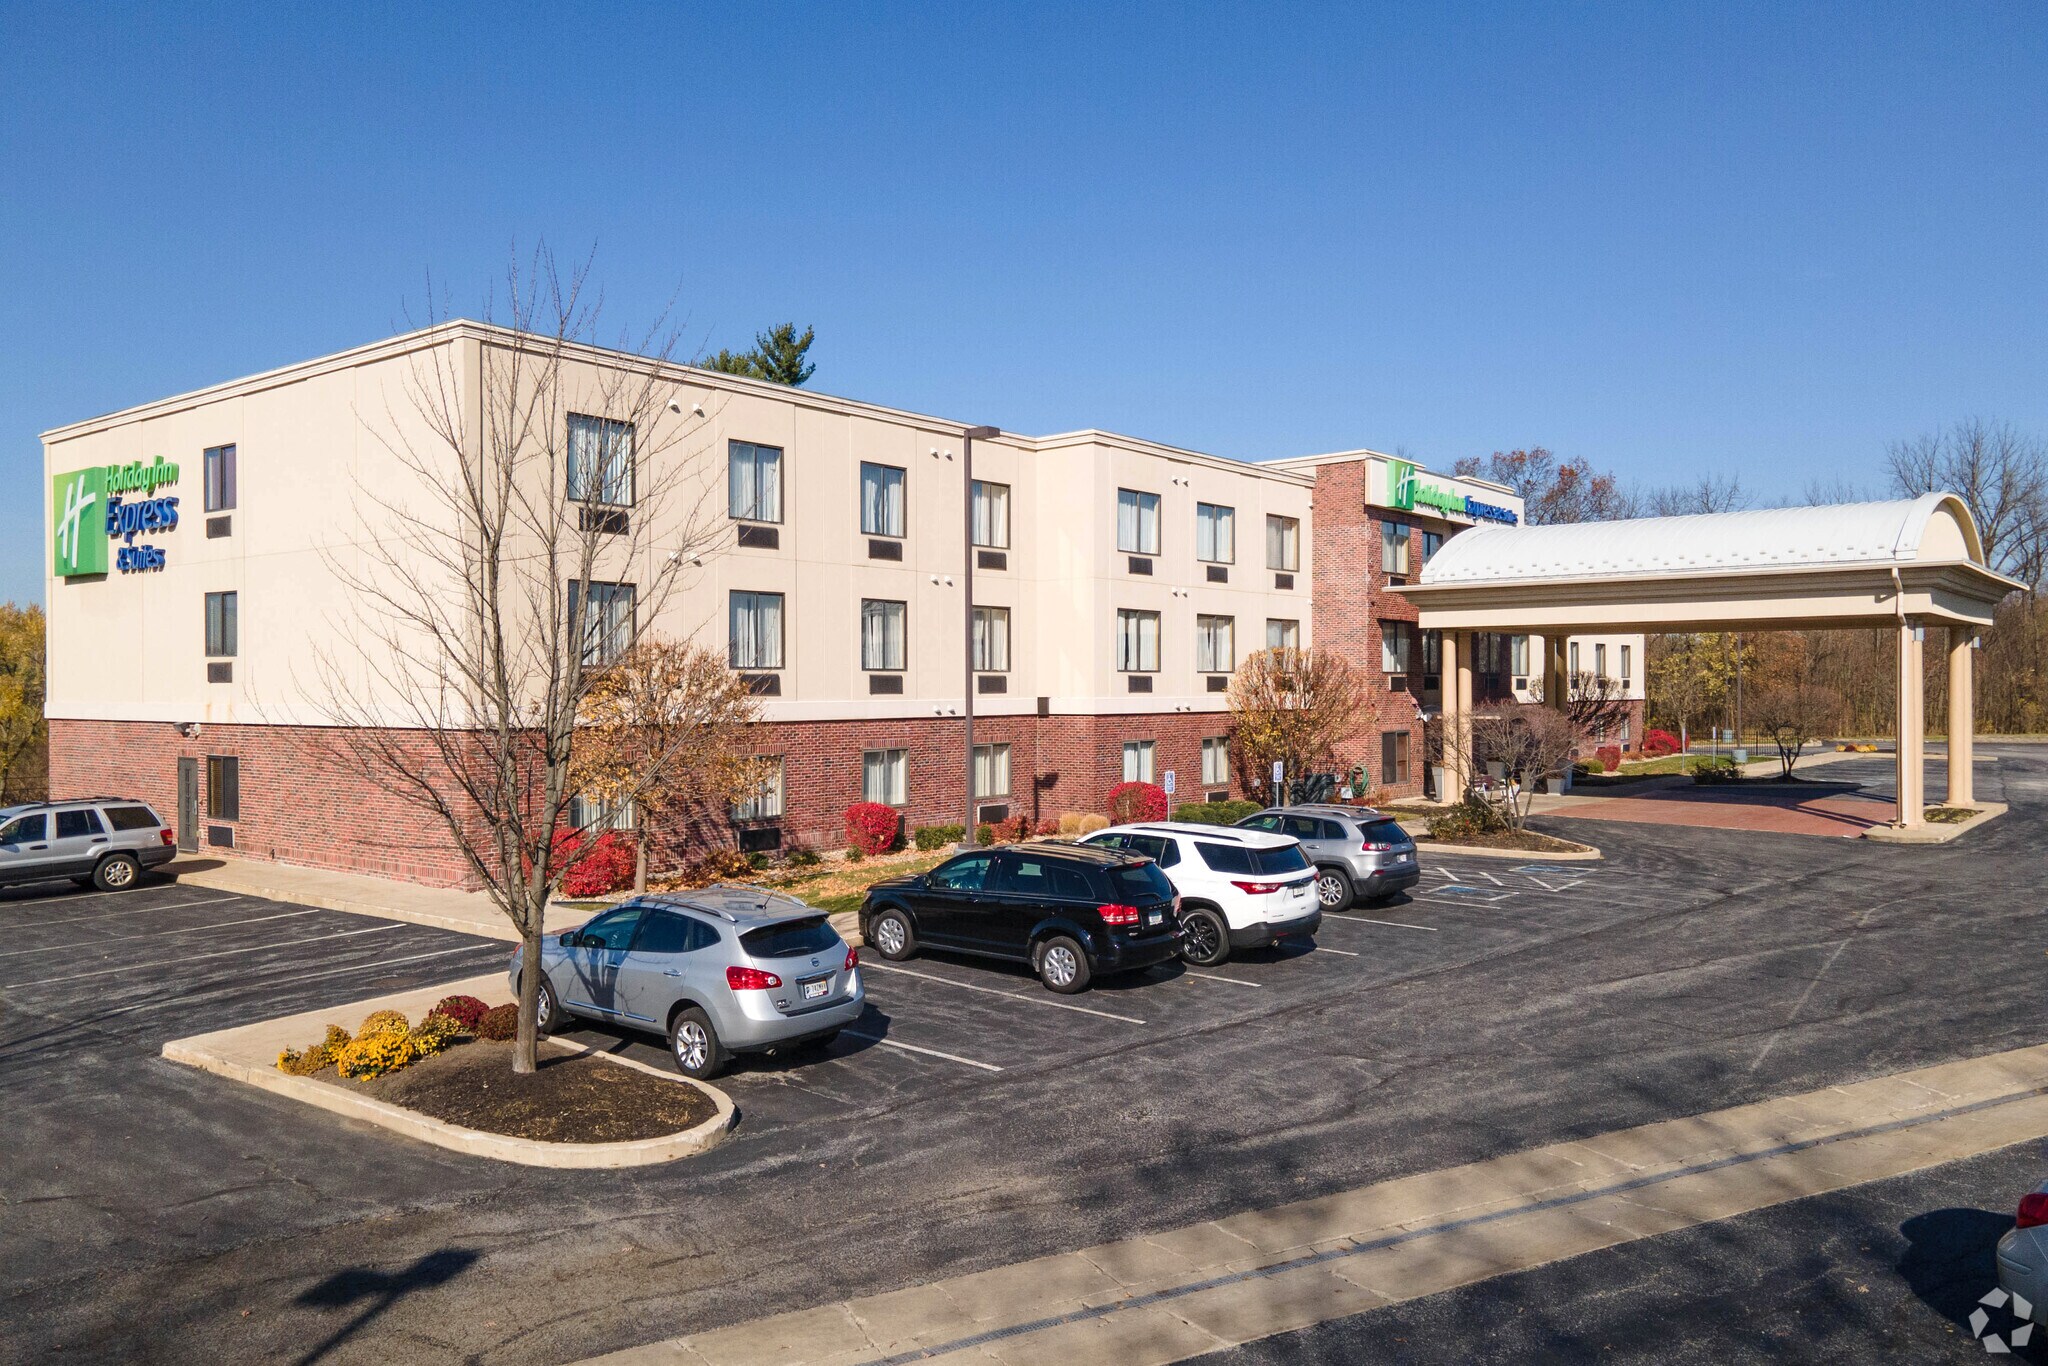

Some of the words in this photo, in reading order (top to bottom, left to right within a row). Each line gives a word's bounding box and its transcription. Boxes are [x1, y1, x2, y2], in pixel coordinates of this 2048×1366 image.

[105, 460, 155, 492] Holiday
[152, 455, 179, 485] Inn
[105, 496, 179, 544] Express
